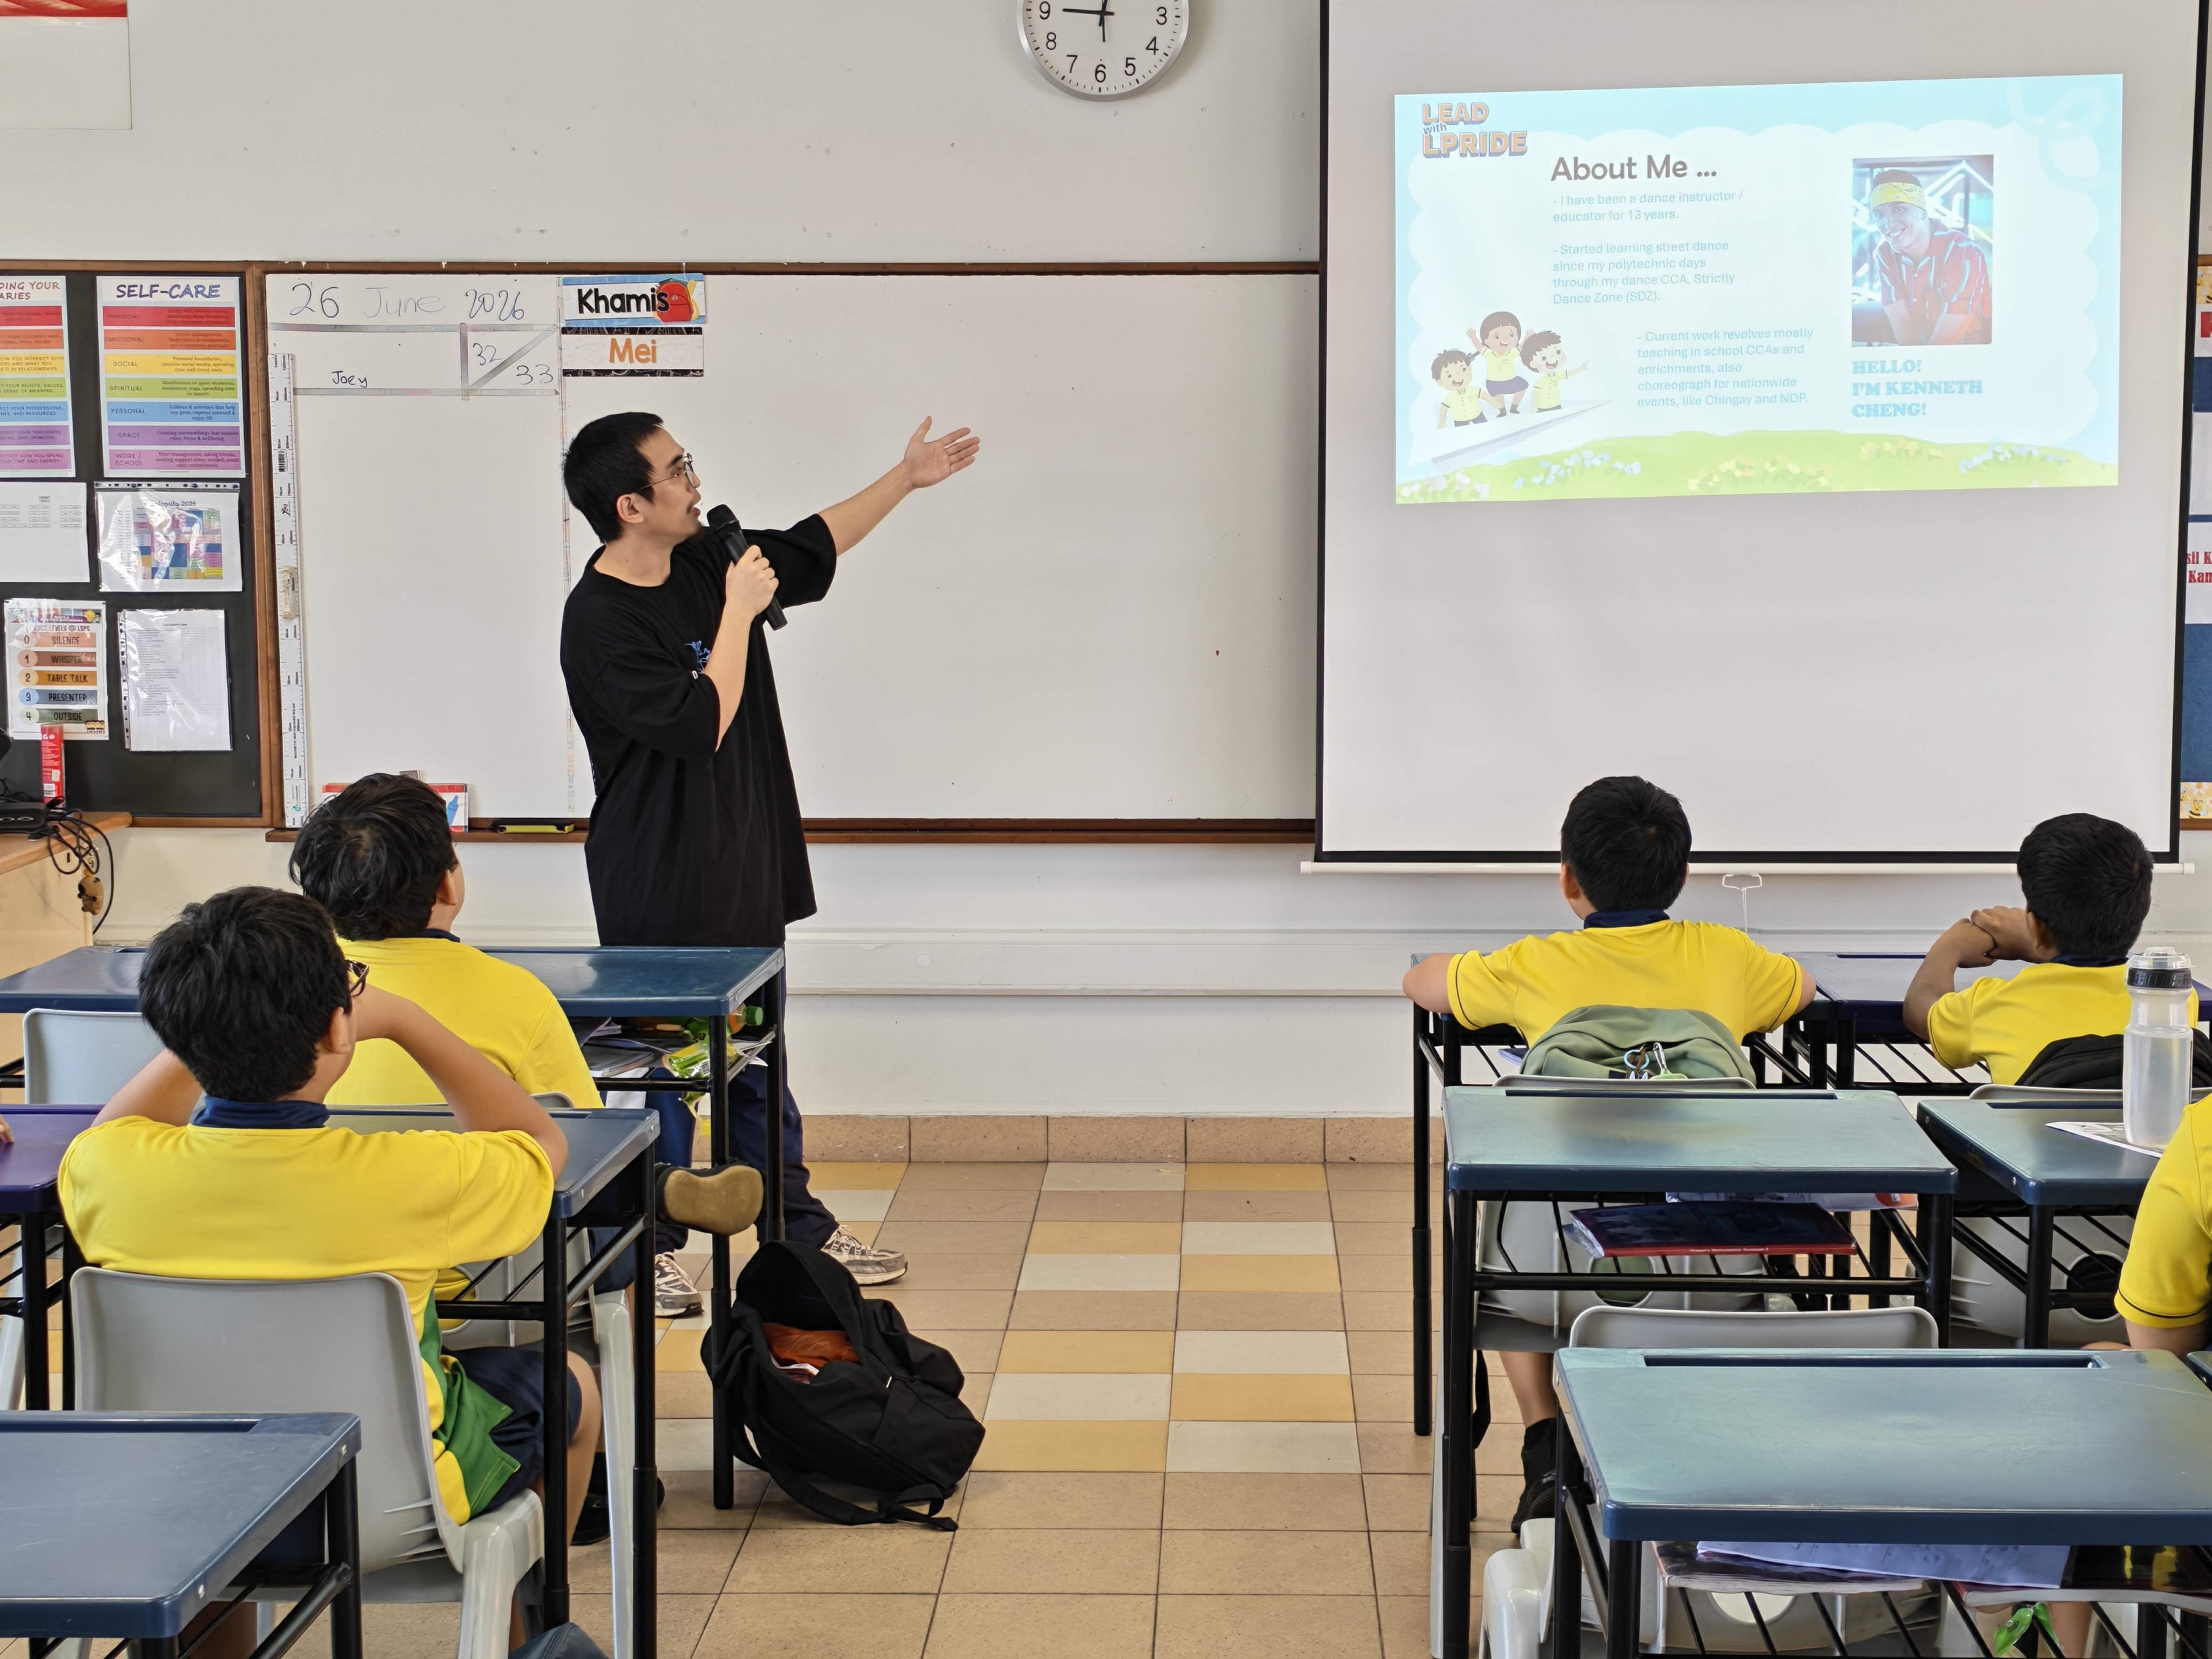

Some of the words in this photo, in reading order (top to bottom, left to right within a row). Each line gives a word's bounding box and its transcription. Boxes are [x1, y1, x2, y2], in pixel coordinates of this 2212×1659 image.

[1039, 1, 1050, 20] 9
[1156, 6, 1168, 25] 3
[1046, 32, 1056, 50] 8
[1145, 36, 1159, 55] 4
[1067, 55, 1078, 73] 7
[1124, 57, 1136, 76] 5
[1095, 64, 1107, 83] 6
[1422, 102, 1489, 125] LEAD
[1423, 123, 1447, 134] with
[1423, 131, 1527, 158] LPRIDE
[1551, 157, 1637, 181] About
[1647, 154, 1688, 178] Me
[1561, 196, 1563, 205] I
[1567, 195, 1594, 205] have
[1598, 194, 1626, 204] been
[1640, 193, 1675, 203] dance
[1679, 192, 1736, 203] instructor
[1553, 211, 1604, 222] educator
[1609, 210, 1624, 220] for
[1629, 211, 1641, 220] 13
[1645, 210, 1679, 221] years.
[1560, 244, 1603, 255] Started
[1607, 244, 1653, 254] learning
[1656, 242, 1689, 252] street
[1692, 241, 1729, 251] dance
[1553, 261, 1584, 272] since
[1588, 263, 1605, 272] my
[1608, 258, 1676, 271] polytechnic
[1679, 258, 1706, 268] days
[29, 281, 60, 289] YOUR
[1553, 276, 1598, 289] through
[1601, 279, 1619, 288] my
[1622, 275, 1657, 285] dance
[1661, 274, 1691, 286] CCA,
[1694, 272, 1735, 285] Strictly
[116, 284, 221, 298] SELF-CARE
[1553, 293, 1590, 304] Dance
[1594, 293, 1622, 303] Zone
[1626, 291, 1661, 303] (SDZ).
[290, 283, 339, 318] 26
[363, 287, 446, 318] June
[466, 289, 524, 321] 2026
[577, 287, 670, 314] Khamis
[1645, 331, 1689, 341] Current
[1692, 331, 1720, 340] work
[1723, 329, 1771, 340] revolves
[1775, 328, 1813, 339] mostly
[473, 343, 503, 366] 32
[609, 338, 657, 363] Mei
[1638, 347, 1688, 359] teaching
[1691, 347, 1701, 356] in
[1704, 345, 1743, 356] school
[1746, 345, 1779, 355] CCAs
[1782, 344, 1804, 354] and
[1638, 363, 1715, 375] enrichments,
[1718, 363, 1742, 373] also
[1852, 360, 1921, 374] HELLO!
[332, 370, 368, 388] Joey
[516, 365, 553, 385] 33
[1638, 379, 1711, 392] choreograph
[1714, 379, 1730, 388] for
[1732, 377, 1797, 388] nationwide
[1852, 382, 1880, 396] I'M
[1885, 380, 1982, 395] KENNETH
[1638, 397, 1680, 408] events,
[1683, 395, 1702, 406] like
[1705, 394, 1752, 407] Chingay
[1755, 394, 1777, 404] and
[1780, 393, 1808, 403] NDP.
[1852, 403, 1927, 417] CHENG!
[24, 635, 30, 644] 0
[52, 636, 80, 645] SILENCE
[25, 655, 29, 664] 1
[25, 673, 31, 682] 2
[47, 673, 68, 683] TABLE
[70, 674, 88, 683] TALK
[26, 692, 31, 702] 3
[49, 692, 87, 702] PRESENTER
[26, 711, 31, 721] 4
[53, 712, 83, 720] OUTSIDE
